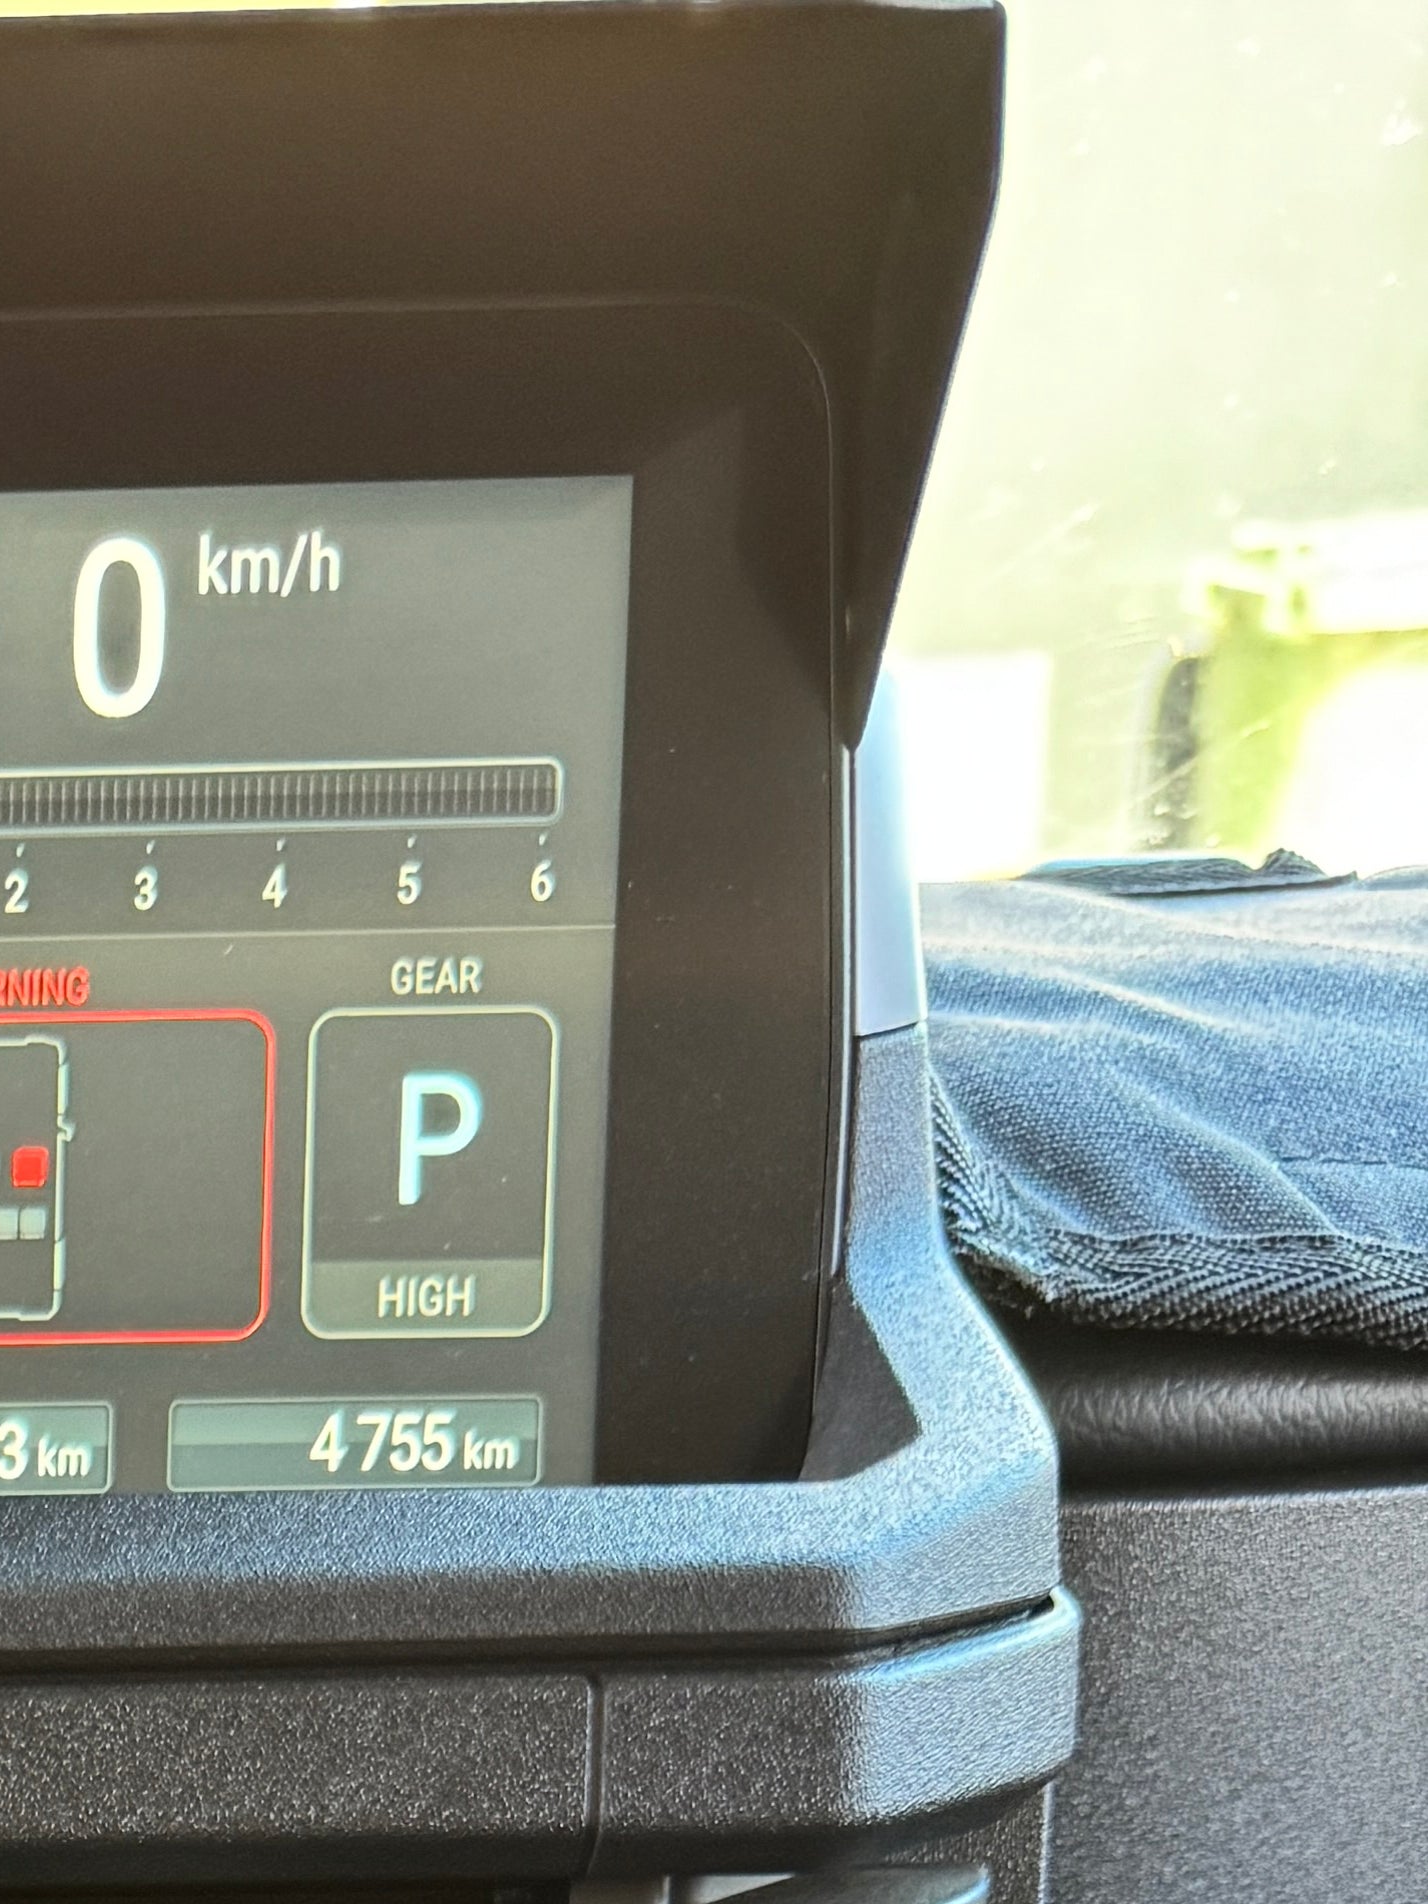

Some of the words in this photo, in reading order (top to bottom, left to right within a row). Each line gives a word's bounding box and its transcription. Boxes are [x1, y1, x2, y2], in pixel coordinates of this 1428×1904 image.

[72, 538, 166, 718] 0
[199, 527, 340, 597] km/h
[5, 868, 28, 913] 2
[134, 866, 157, 910] 3
[262, 864, 287, 908] 4
[397, 861, 421, 904] 5
[531, 860, 555, 901] 6
[391, 956, 483, 995] GEAR
[399, 1071, 483, 1205] P
[378, 1274, 476, 1317] HIGH
[37, 1436, 93, 1478] km
[464, 1426, 519, 1469] km
